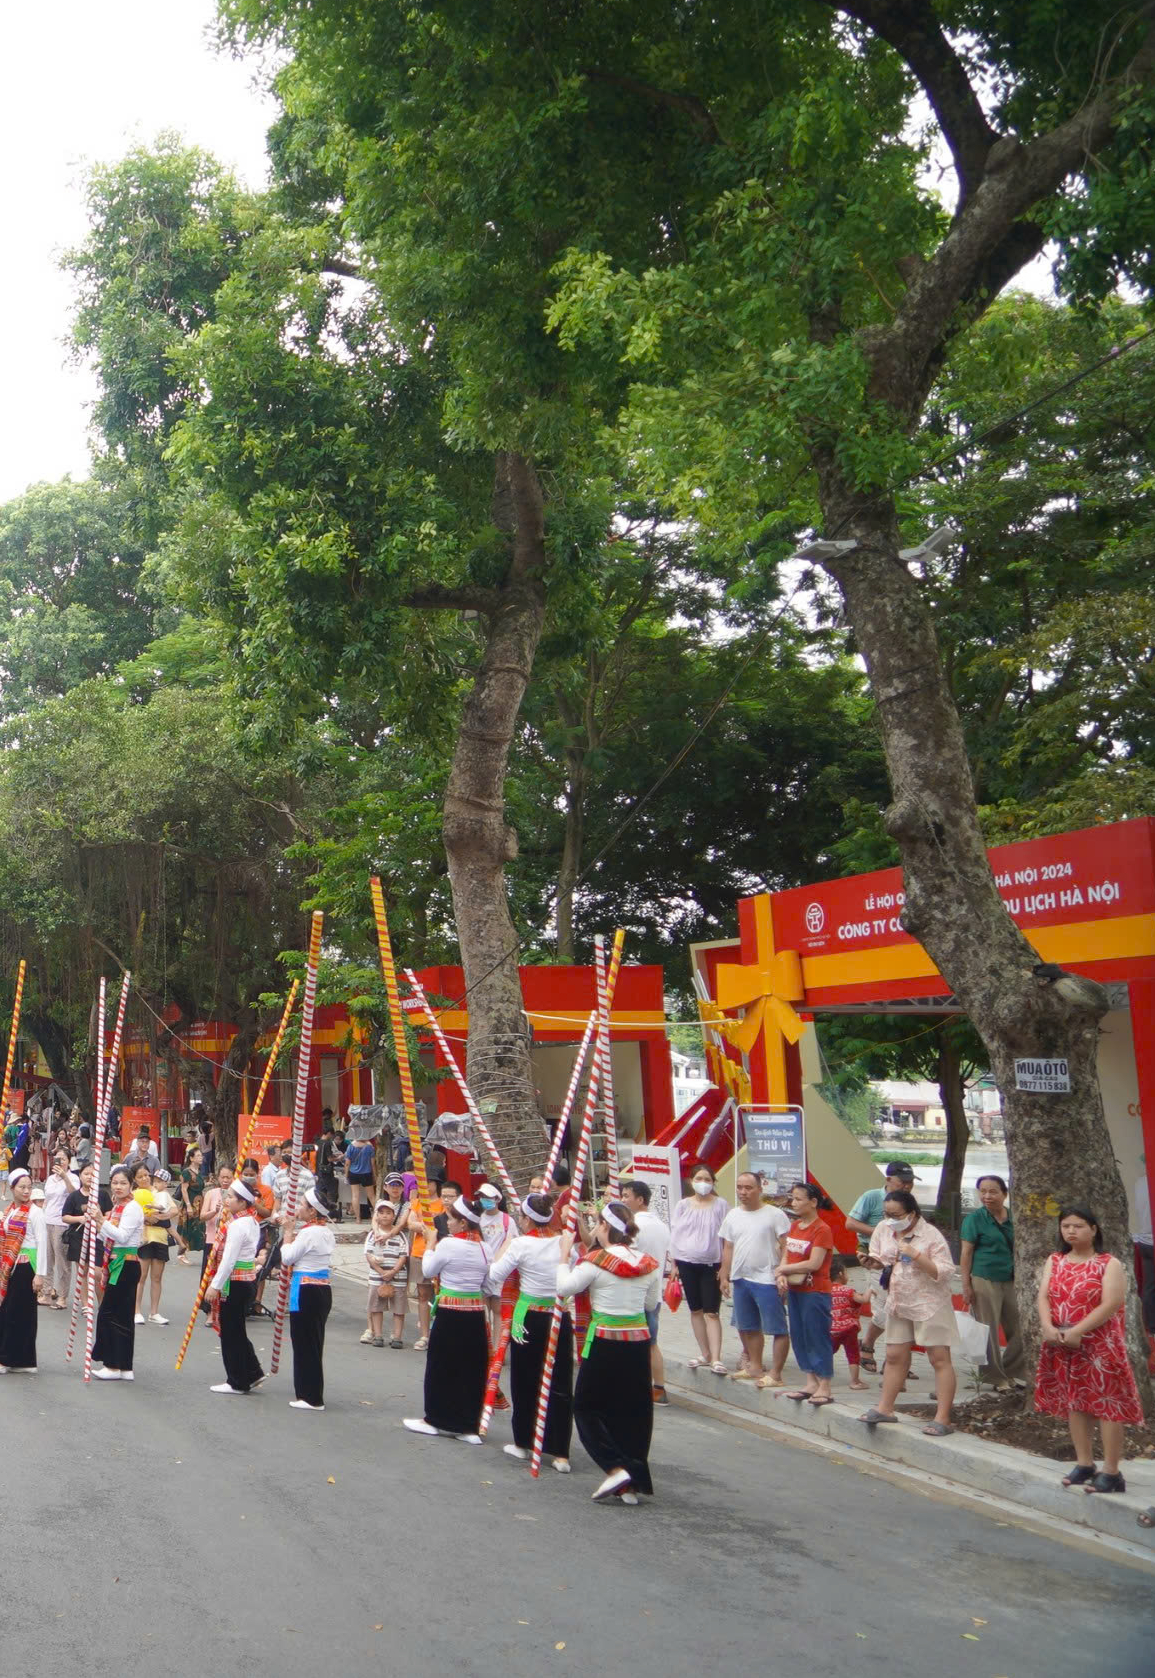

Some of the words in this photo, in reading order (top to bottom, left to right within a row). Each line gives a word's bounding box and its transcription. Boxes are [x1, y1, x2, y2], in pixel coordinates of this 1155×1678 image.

[877, 893, 894, 909] HỘI
[994, 870, 1012, 888] HÀ
[1015, 867, 1038, 885] NỘI
[1041, 862, 1072, 880] 2024
[838, 922, 871, 939] CÔNG
[873, 920, 887, 934] TY
[1024, 893, 1056, 914] LỊCH
[1060, 884, 1084, 907] HÀ
[1087, 880, 1120, 904] NỘI
[757, 1139, 778, 1150] THÚ
[781, 1140, 791, 1154] VỊ
